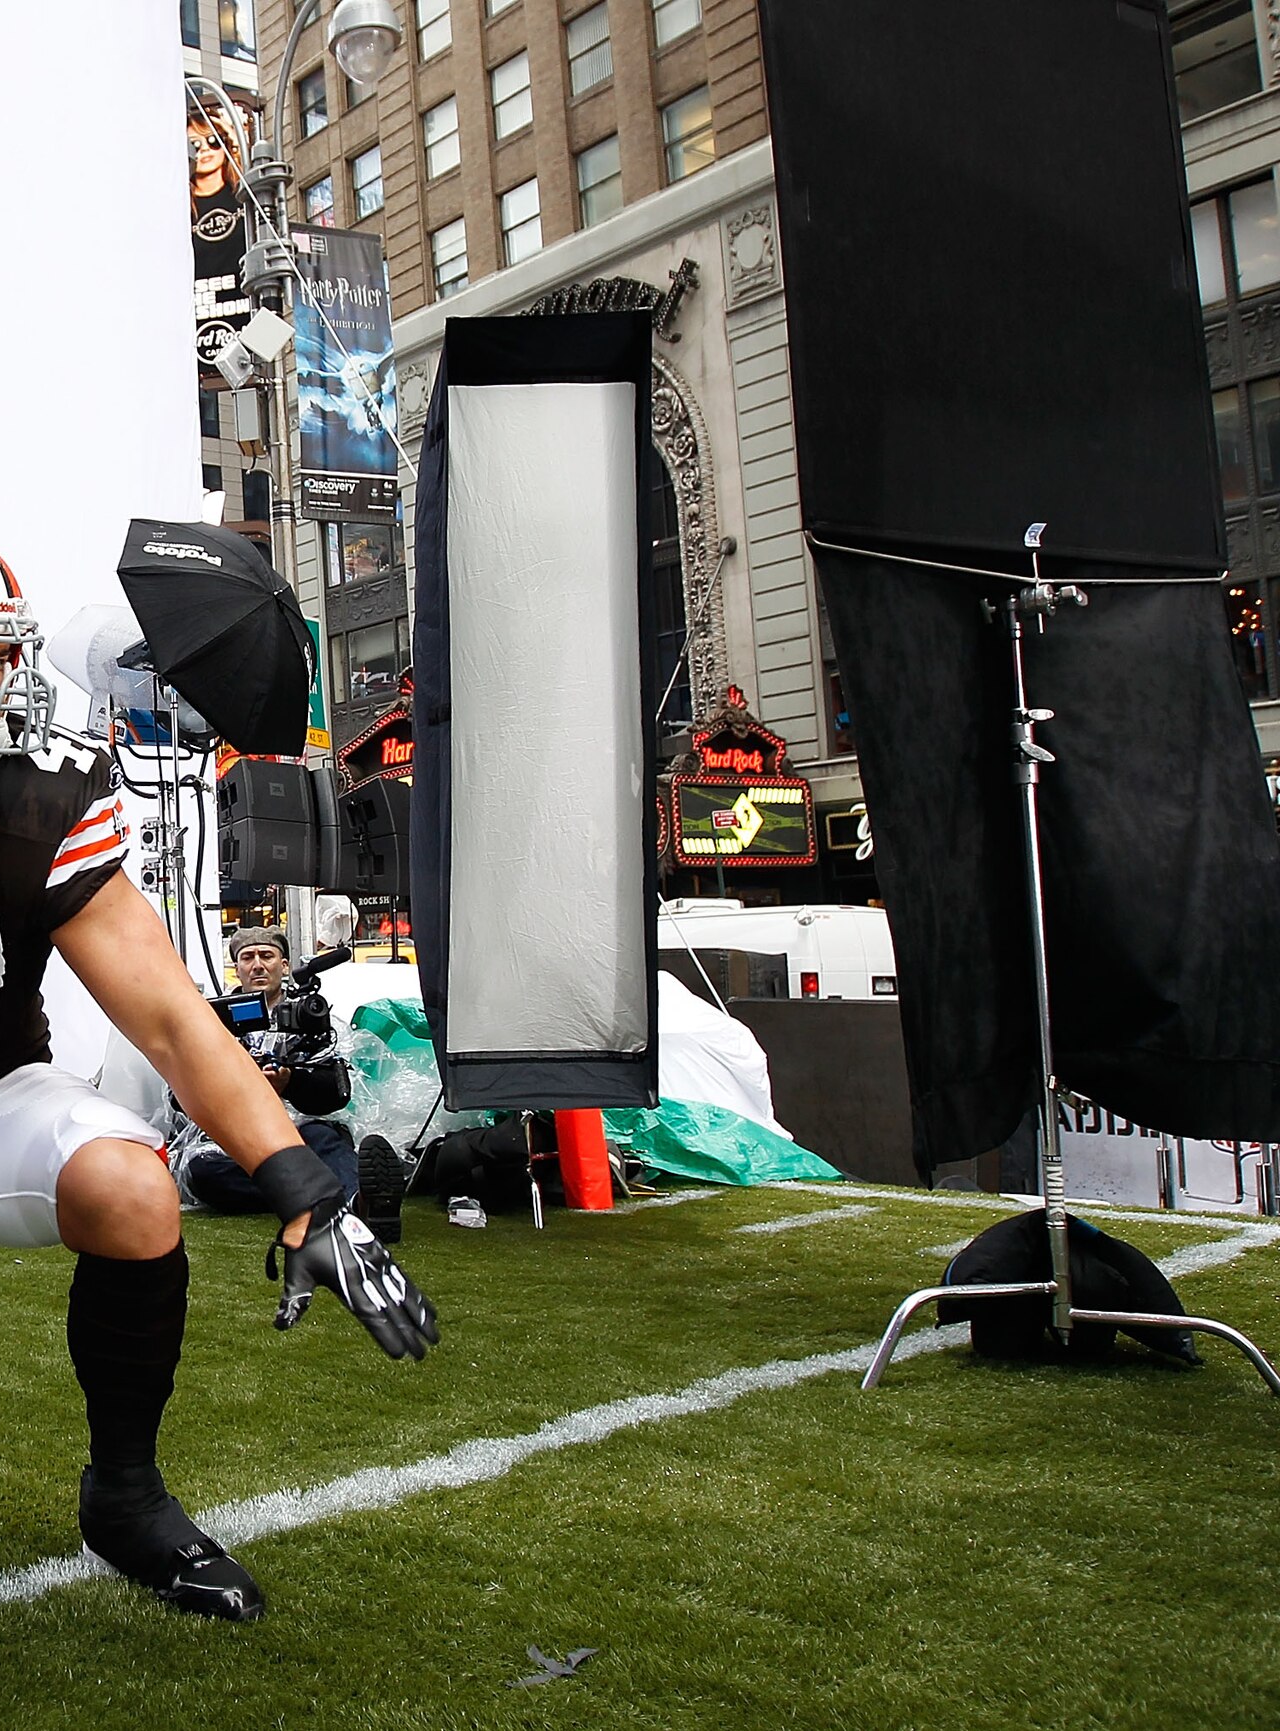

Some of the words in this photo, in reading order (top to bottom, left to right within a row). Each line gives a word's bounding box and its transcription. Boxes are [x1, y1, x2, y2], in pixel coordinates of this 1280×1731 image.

[192, 216, 214, 233] ard
[195, 274, 235, 293] SEE
[195, 290, 217, 306] HE
[300, 277, 338, 307] Harry
[336, 277, 382, 316] Potter
[196, 298, 250, 320] SHOW
[214, 325, 247, 346] Roc
[205, 347, 222, 358] CAF
[308, 478, 356, 494] Discovery
[143, 544, 224, 567] Profoto
[381, 738, 415, 764] Har
[702, 747, 732, 769] Hard
[732, 748, 764, 773] Rock
[358, 896, 378, 906] ROCK
